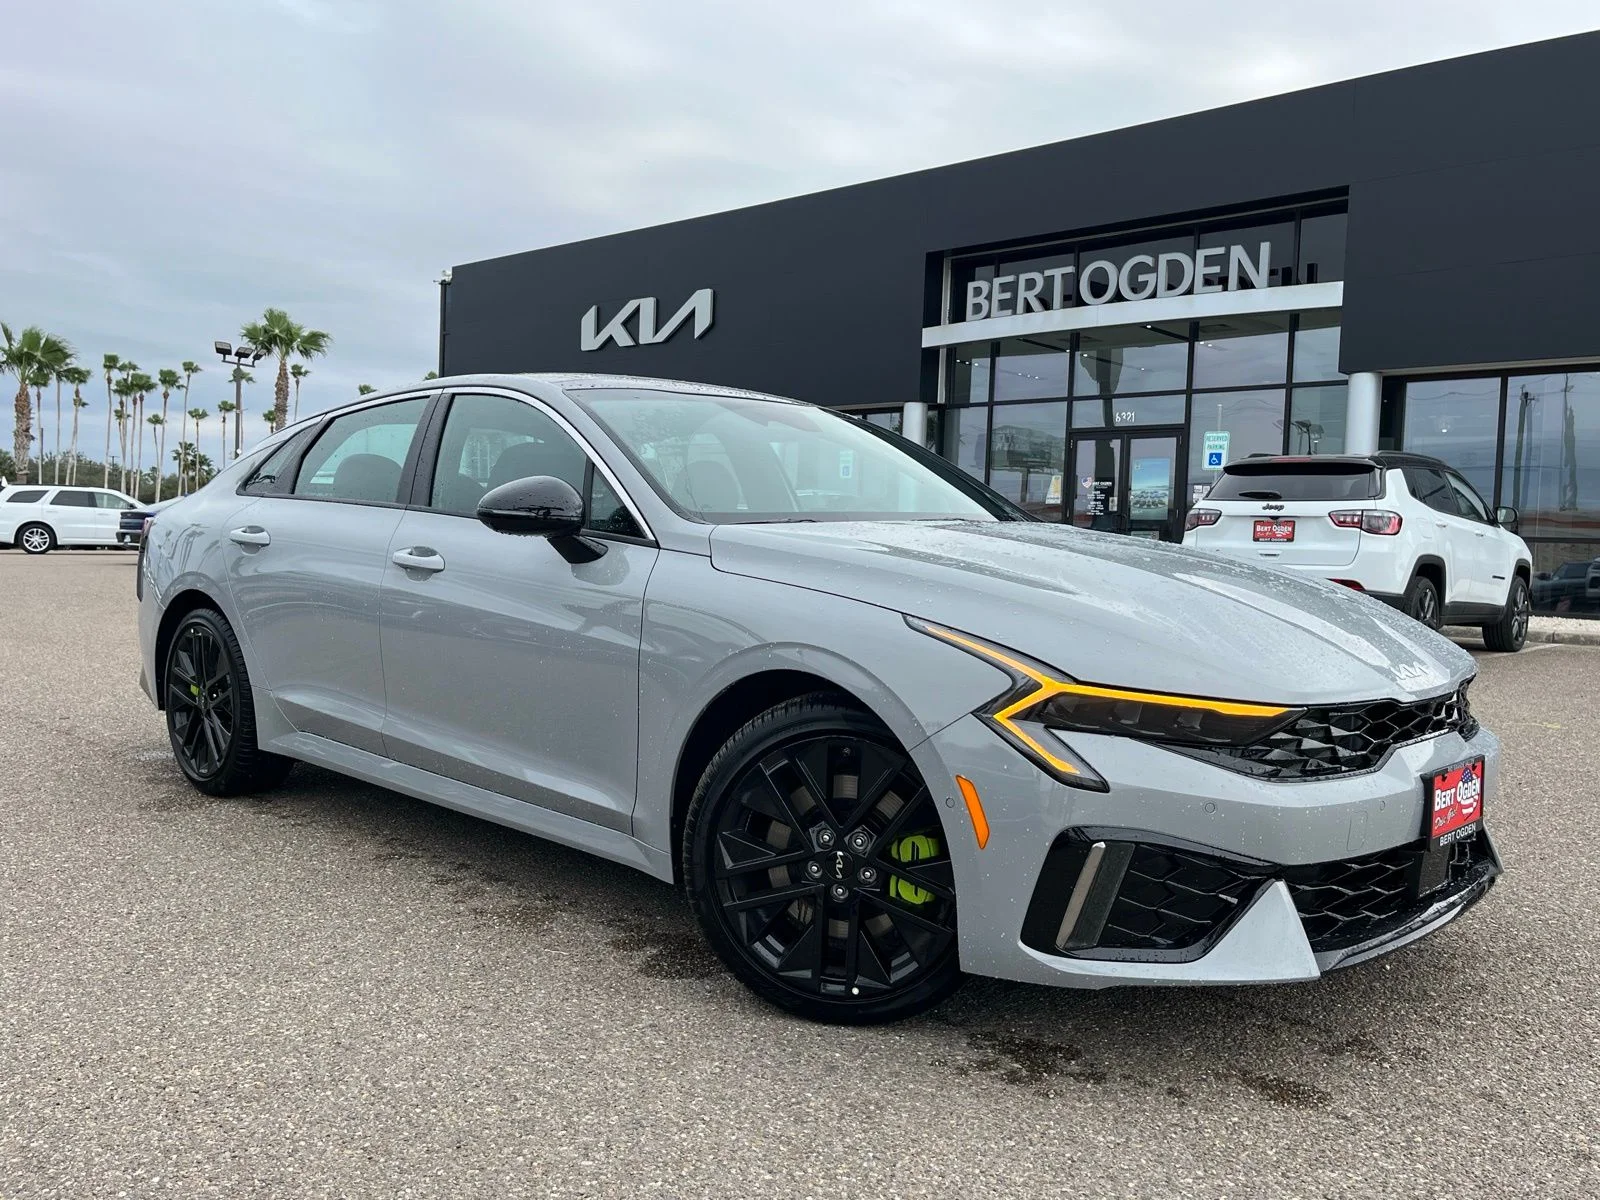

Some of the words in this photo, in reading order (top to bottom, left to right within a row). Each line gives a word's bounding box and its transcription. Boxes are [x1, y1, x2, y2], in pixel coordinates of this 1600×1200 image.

[965, 265, 1075, 322] BERT
[1079, 241, 1271, 305] OGDEN
[581, 288, 713, 351] KIA
[1115, 411, 1135, 423] 6321
[1262, 503, 1284, 511] Jeep
[1434, 788, 1455, 812] BERT
[1457, 778, 1480, 802] OGDEN
[1440, 831, 1455, 846] BERT
[1456, 822, 1476, 839] OGDEN
